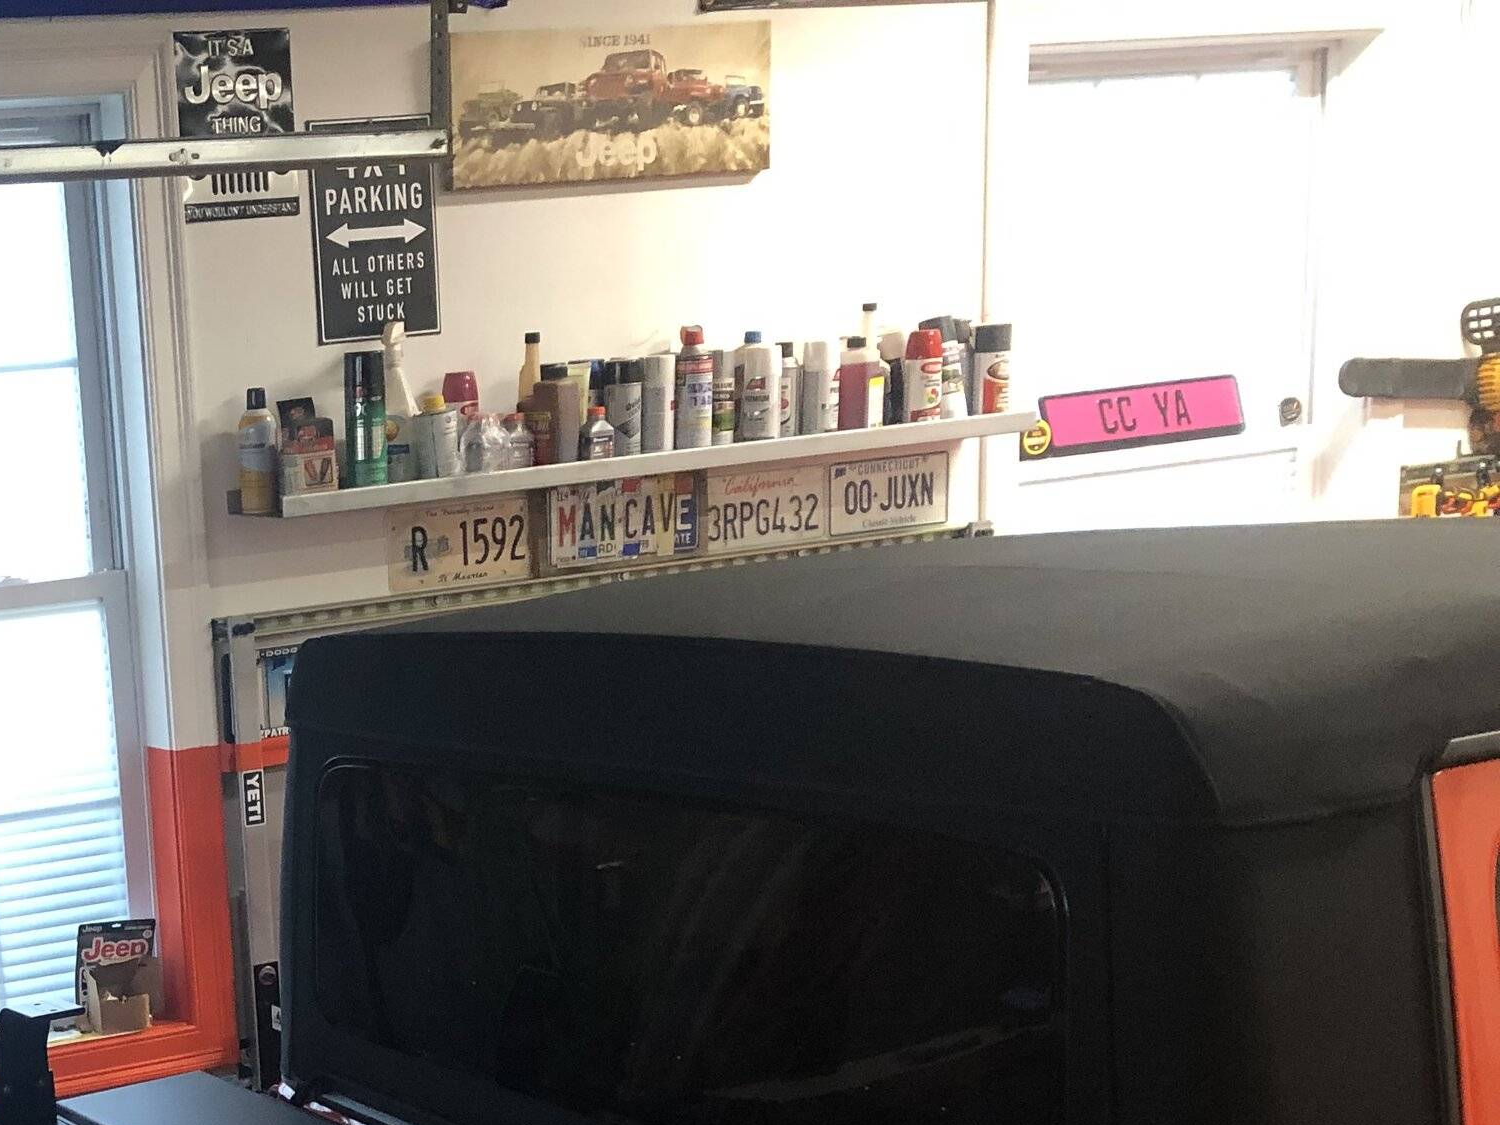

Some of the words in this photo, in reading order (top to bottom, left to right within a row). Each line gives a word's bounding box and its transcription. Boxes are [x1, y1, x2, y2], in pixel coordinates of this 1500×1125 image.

[242, 39, 254, 56] A
[580, 34, 620, 48] SINCE
[623, 33, 651, 47] 1941
[184, 65, 283, 110] Jeep
[212, 115, 261, 135] THING
[575, 133, 657, 171] Jeep
[325, 182, 423, 216] PARKING
[332, 258, 360, 276] ALL
[367, 252, 425, 273] OTHERS
[341, 282, 378, 300] WILL
[386, 277, 413, 296] GET
[357, 301, 405, 323] STUCK
[1098, 396, 1137, 435] CC
[1152, 389, 1192, 428] YA
[625, 493, 693, 538] CAVE
[706, 493, 819, 542] 3RPG432
[411, 525, 429, 572] R
[458, 514, 526, 567] 1592
[246, 773, 262, 822] YETI
[83, 938, 147, 961] Jeep
